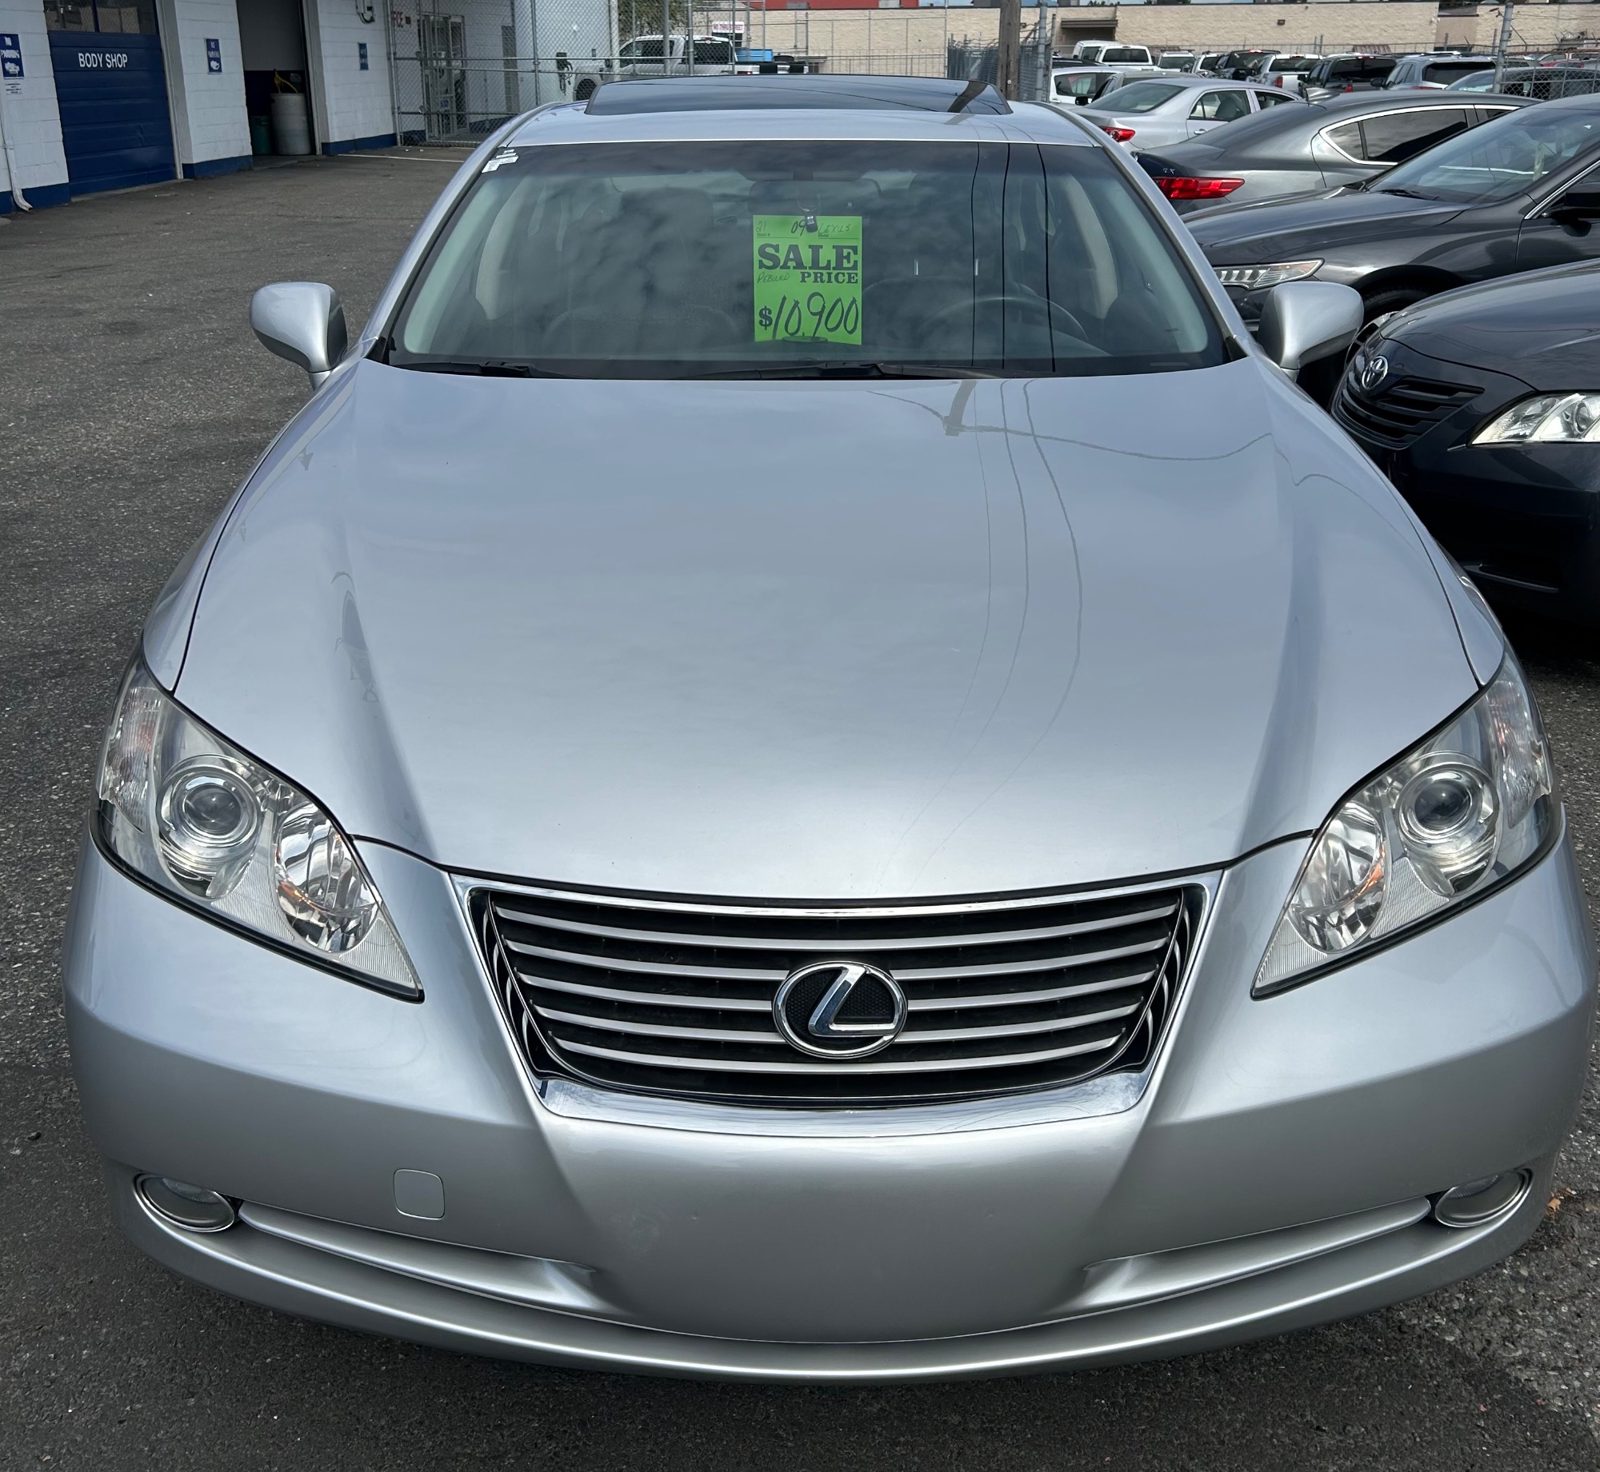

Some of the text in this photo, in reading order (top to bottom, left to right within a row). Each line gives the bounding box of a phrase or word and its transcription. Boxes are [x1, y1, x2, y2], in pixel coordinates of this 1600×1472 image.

[78, 52, 128, 68] BODY SHOP
[758, 243, 859, 270] SALE
[800, 272, 859, 284] PRICE
